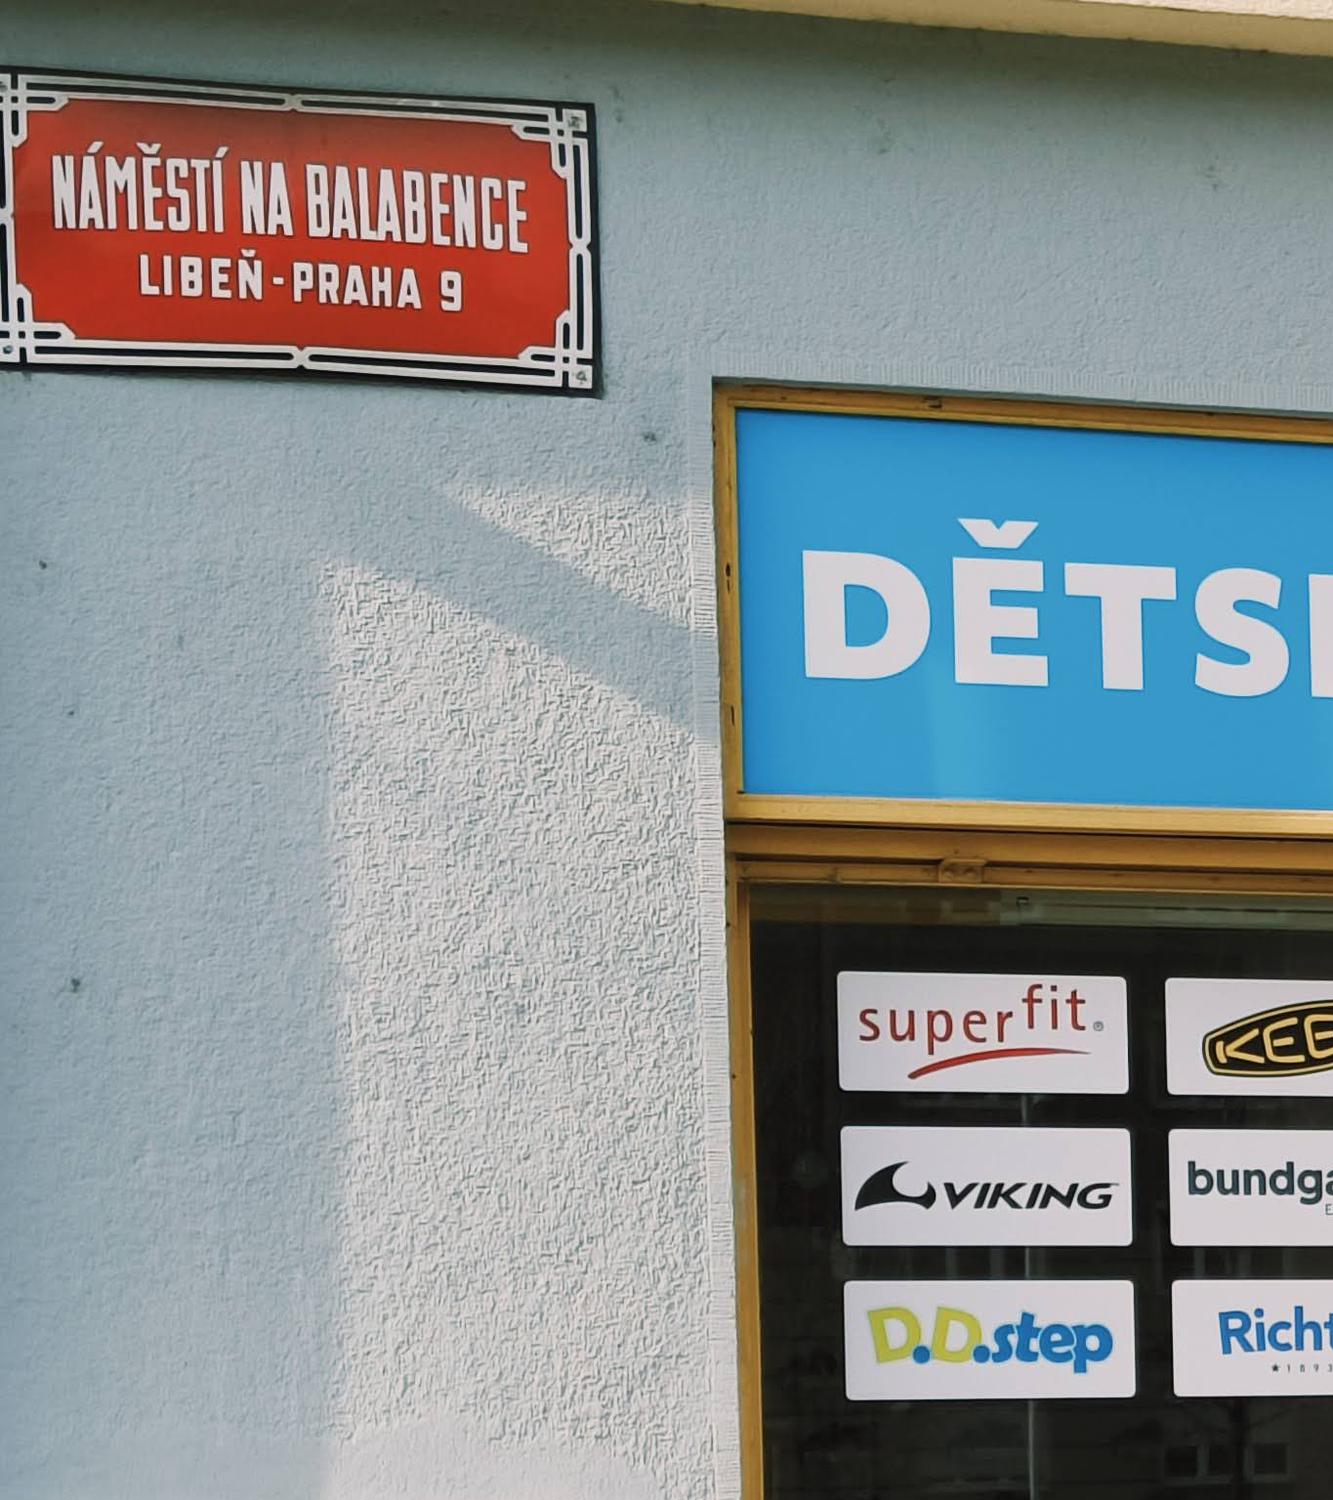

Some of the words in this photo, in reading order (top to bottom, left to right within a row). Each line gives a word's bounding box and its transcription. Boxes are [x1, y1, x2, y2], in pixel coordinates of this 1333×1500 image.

[51, 140, 229, 234] NÁMĚSTÍ
[240, 160, 294, 237] NA
[305, 163, 529, 253] BALABENCE
[440, 270, 463, 313] 9
[857, 983, 1088, 1056] superfit
[943, 1181, 1120, 1211] VIKING
[866, 1304, 1114, 1375] D.D.step
